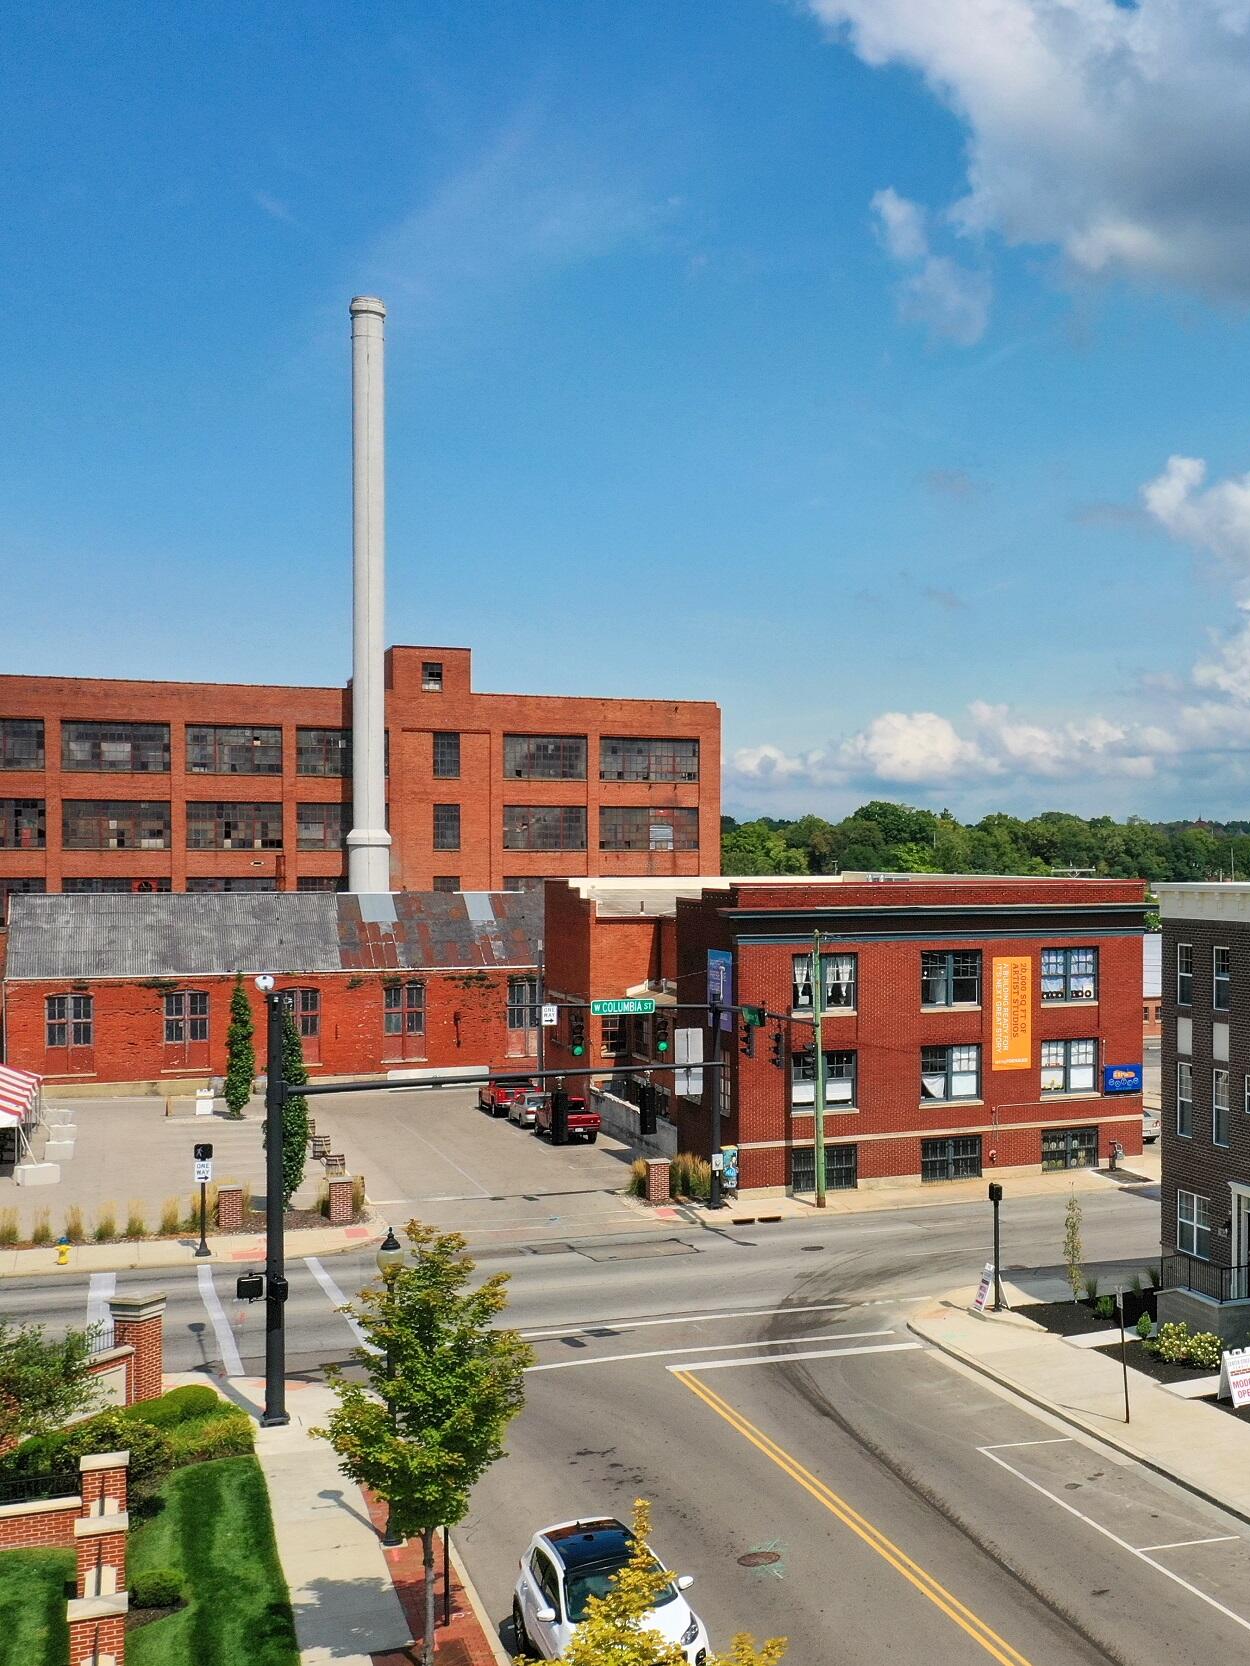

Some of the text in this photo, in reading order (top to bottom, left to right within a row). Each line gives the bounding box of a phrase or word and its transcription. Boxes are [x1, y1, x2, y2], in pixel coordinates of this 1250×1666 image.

[1019, 994, 1027, 1006] SQ
[594, 1001, 653, 1013] W COLUMBIA ST
[1020, 1009, 1027, 1019] FT
[1020, 1022, 1027, 1034] OF
